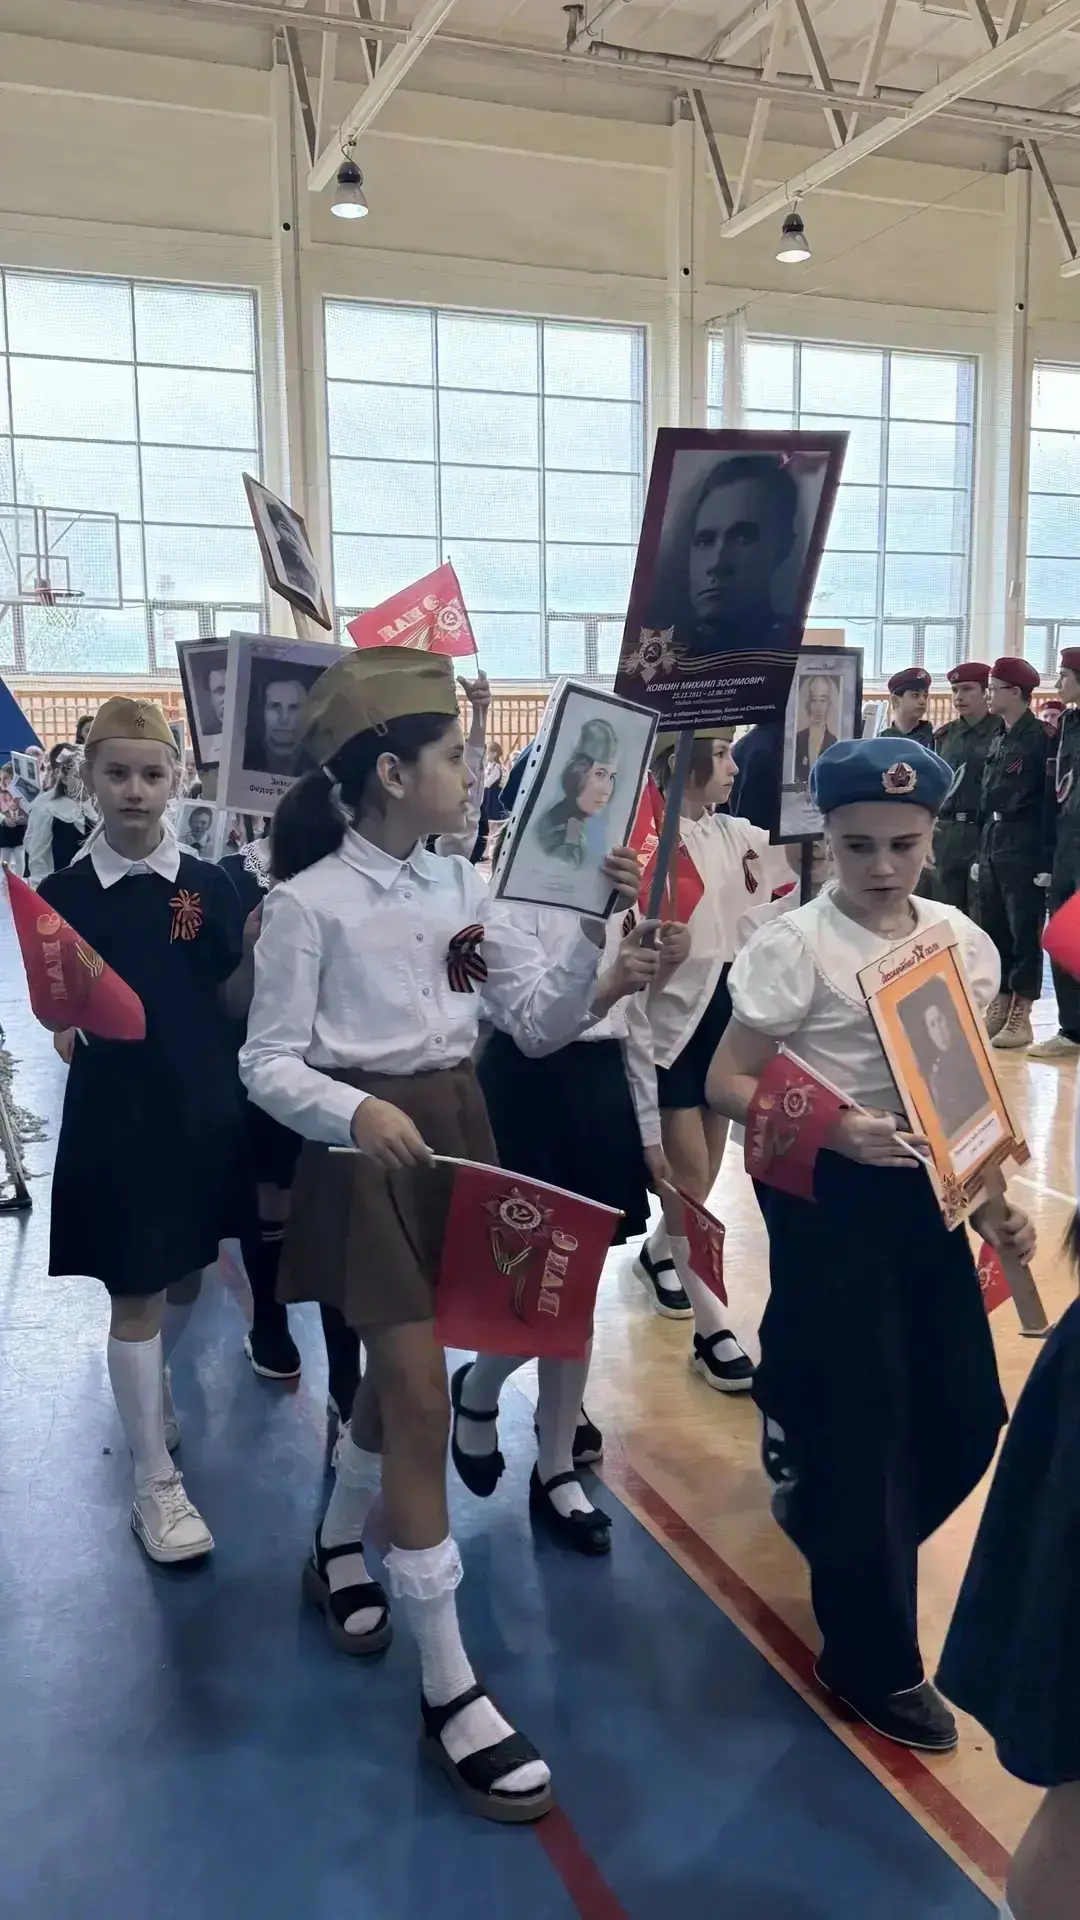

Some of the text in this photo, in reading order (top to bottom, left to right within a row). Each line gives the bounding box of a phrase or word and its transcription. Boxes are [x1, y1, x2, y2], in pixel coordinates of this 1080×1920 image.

[646, 676, 766, 692] КОВКИН МИХАИЛ ЗОСИМОВИЧ
[537, 1230, 579, 1317] 9 МАЯ
